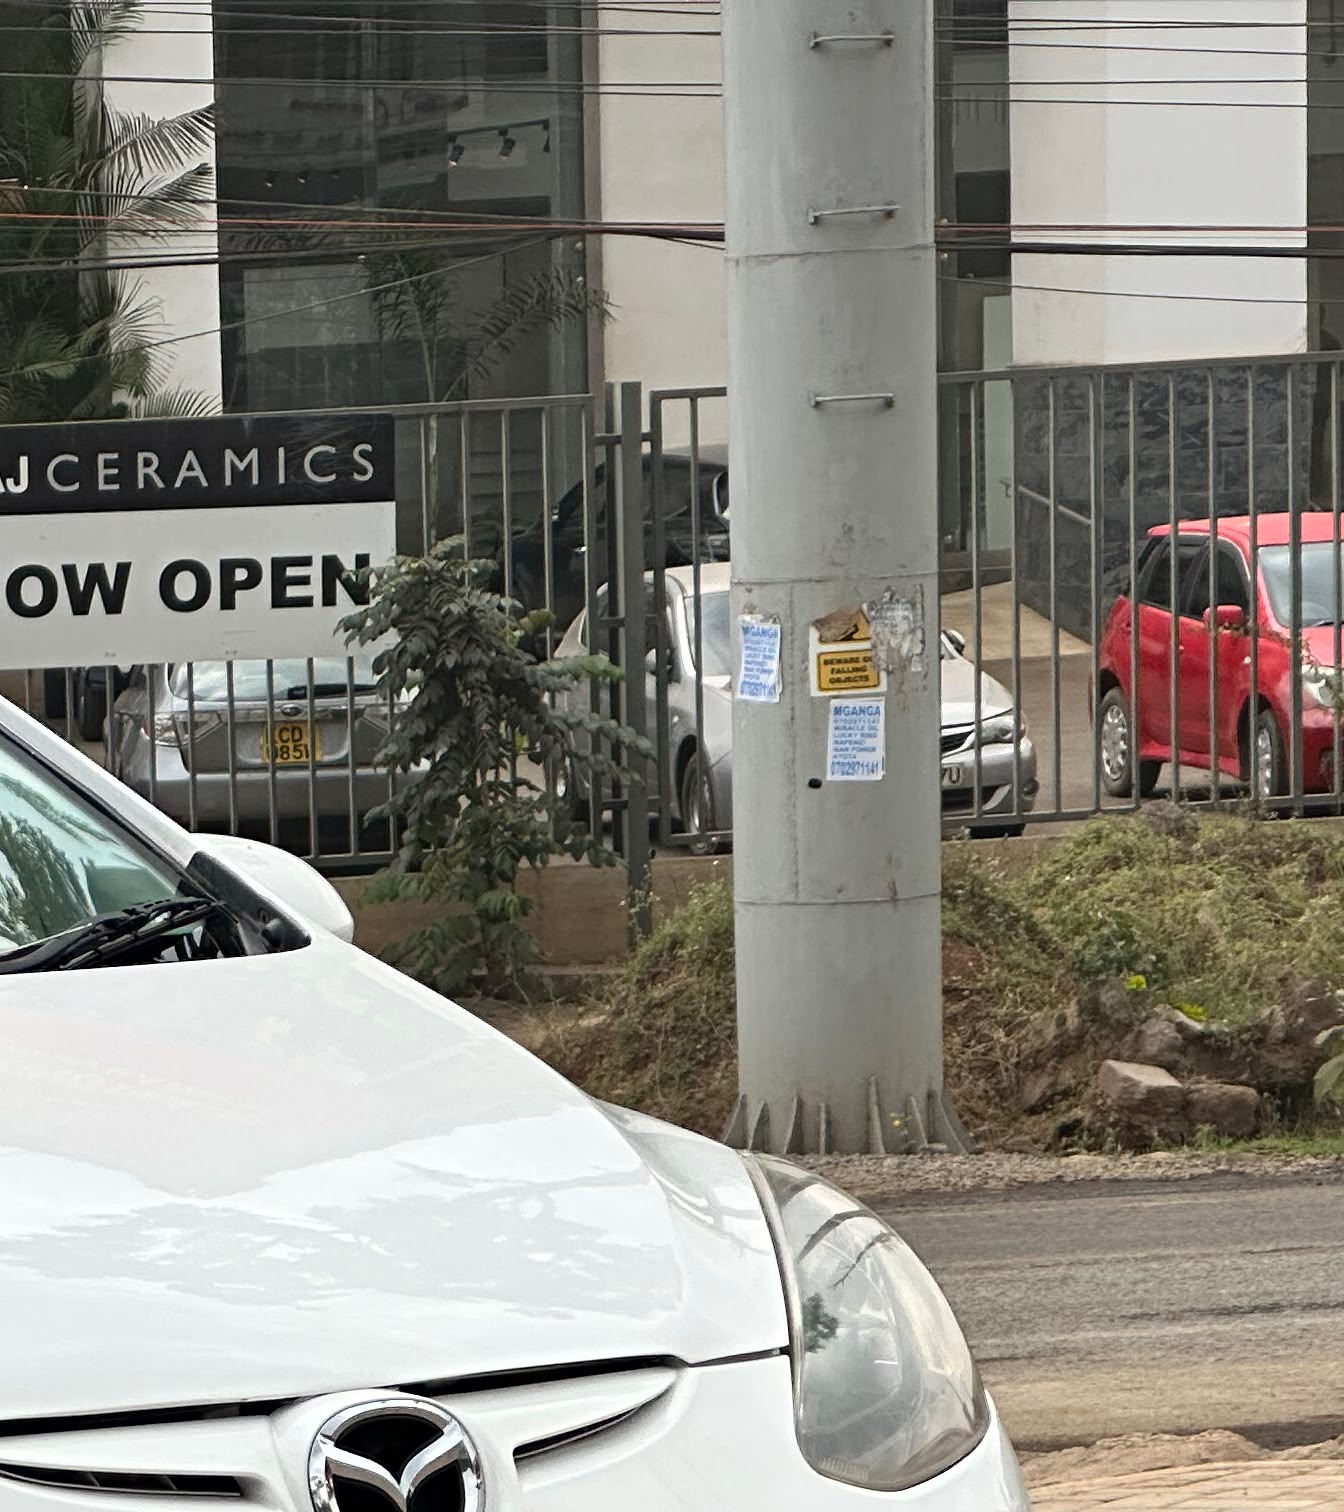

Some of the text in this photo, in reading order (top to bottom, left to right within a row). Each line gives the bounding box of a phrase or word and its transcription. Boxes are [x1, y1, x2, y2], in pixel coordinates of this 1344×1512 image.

[46, 443, 374, 492] CERAMICS
[158, 553, 370, 613] OPEN
[831, 665, 867, 675] FALLING
[829, 674, 869, 684] OBJECTS
[833, 705, 880, 716] MGANGA
[265, 726, 303, 743] CD
